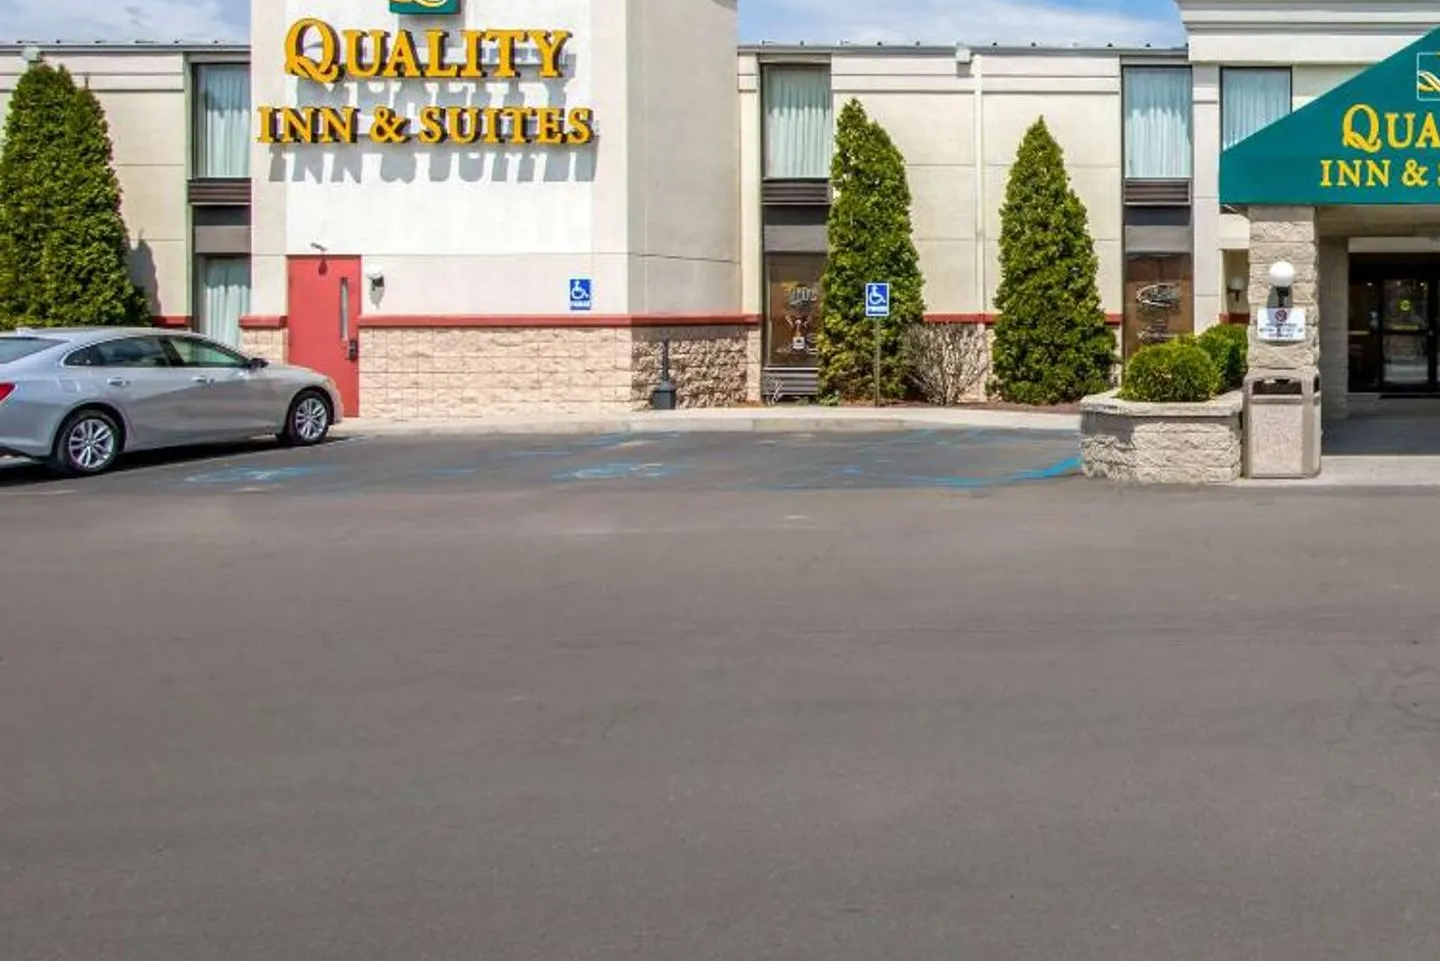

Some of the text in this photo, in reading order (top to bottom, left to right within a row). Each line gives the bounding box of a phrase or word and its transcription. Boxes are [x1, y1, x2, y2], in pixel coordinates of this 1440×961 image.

[285, 18, 572, 83] QUALITY
[257, 105, 596, 145] INN & SUITES
[1320, 159, 1391, 187] INN
[1401, 159, 1428, 187] &
